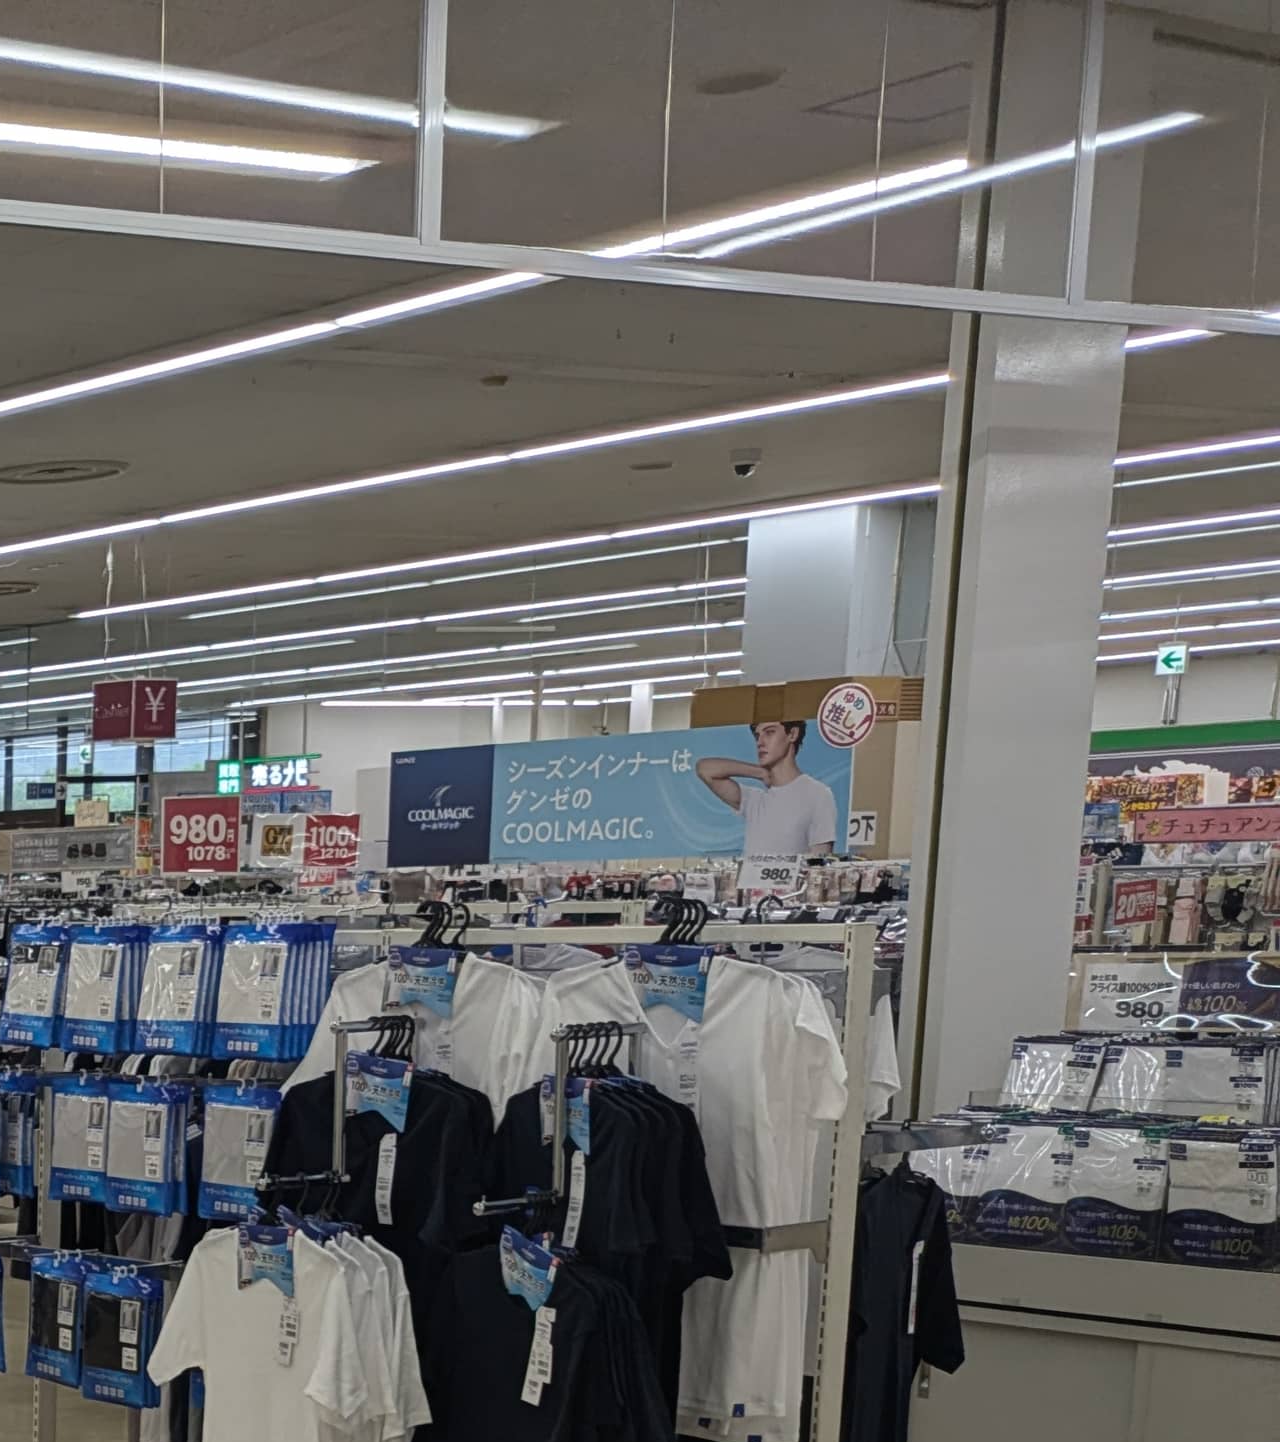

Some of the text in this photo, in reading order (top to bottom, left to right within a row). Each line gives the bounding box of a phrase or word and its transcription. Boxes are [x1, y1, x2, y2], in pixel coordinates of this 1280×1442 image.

[251, 759, 308, 787] 売るナビ
[508, 748, 692, 783] シーズンインナーは
[408, 806, 474, 823] COOLMAGIC
[506, 789, 591, 815] グンゼの
